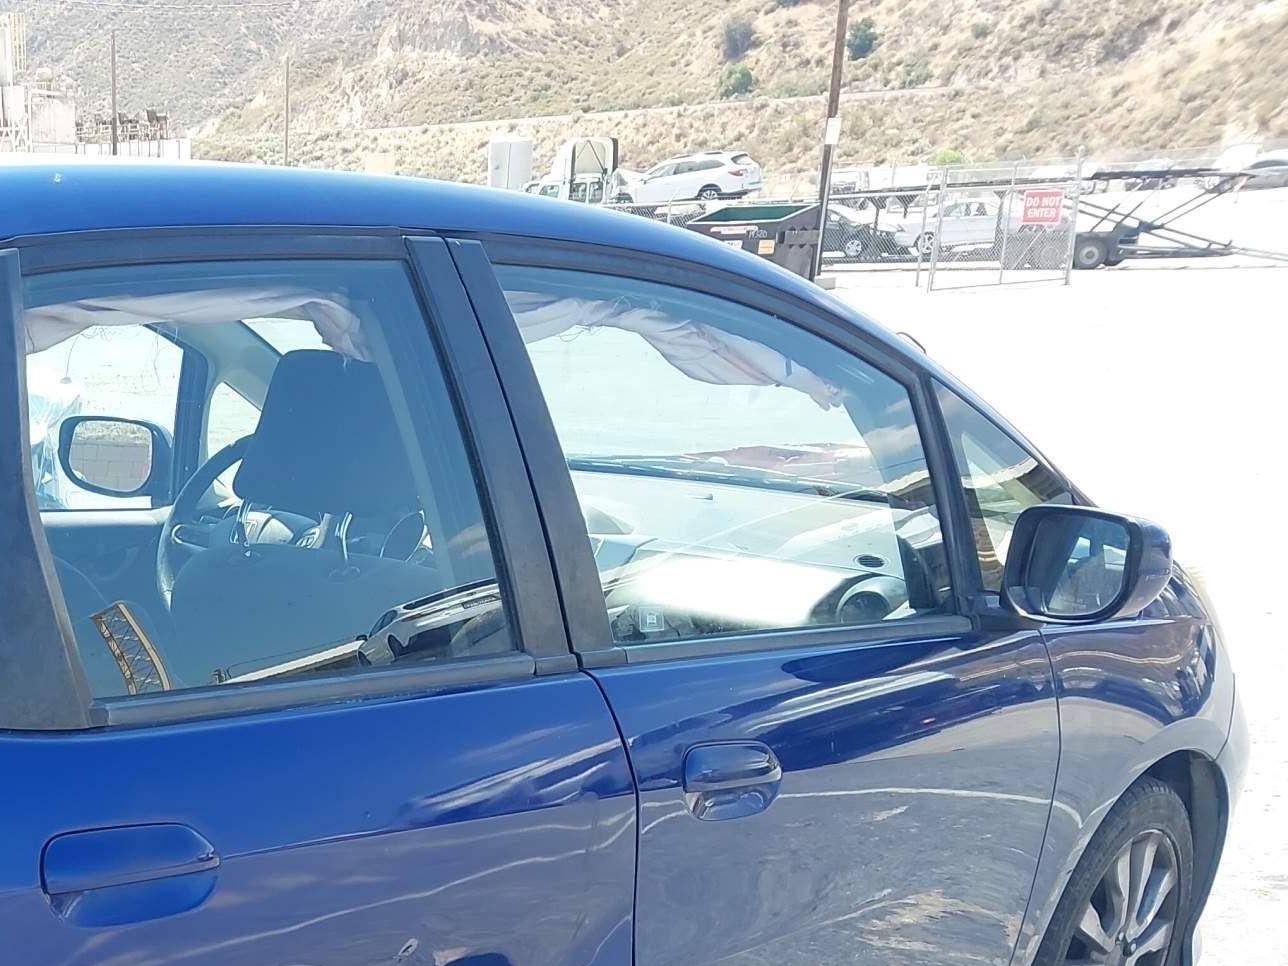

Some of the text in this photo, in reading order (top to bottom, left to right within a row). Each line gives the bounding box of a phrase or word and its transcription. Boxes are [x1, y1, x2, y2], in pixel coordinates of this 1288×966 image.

[1025, 196, 1061, 207] DO NOT
[1027, 208, 1056, 218] ENTER
